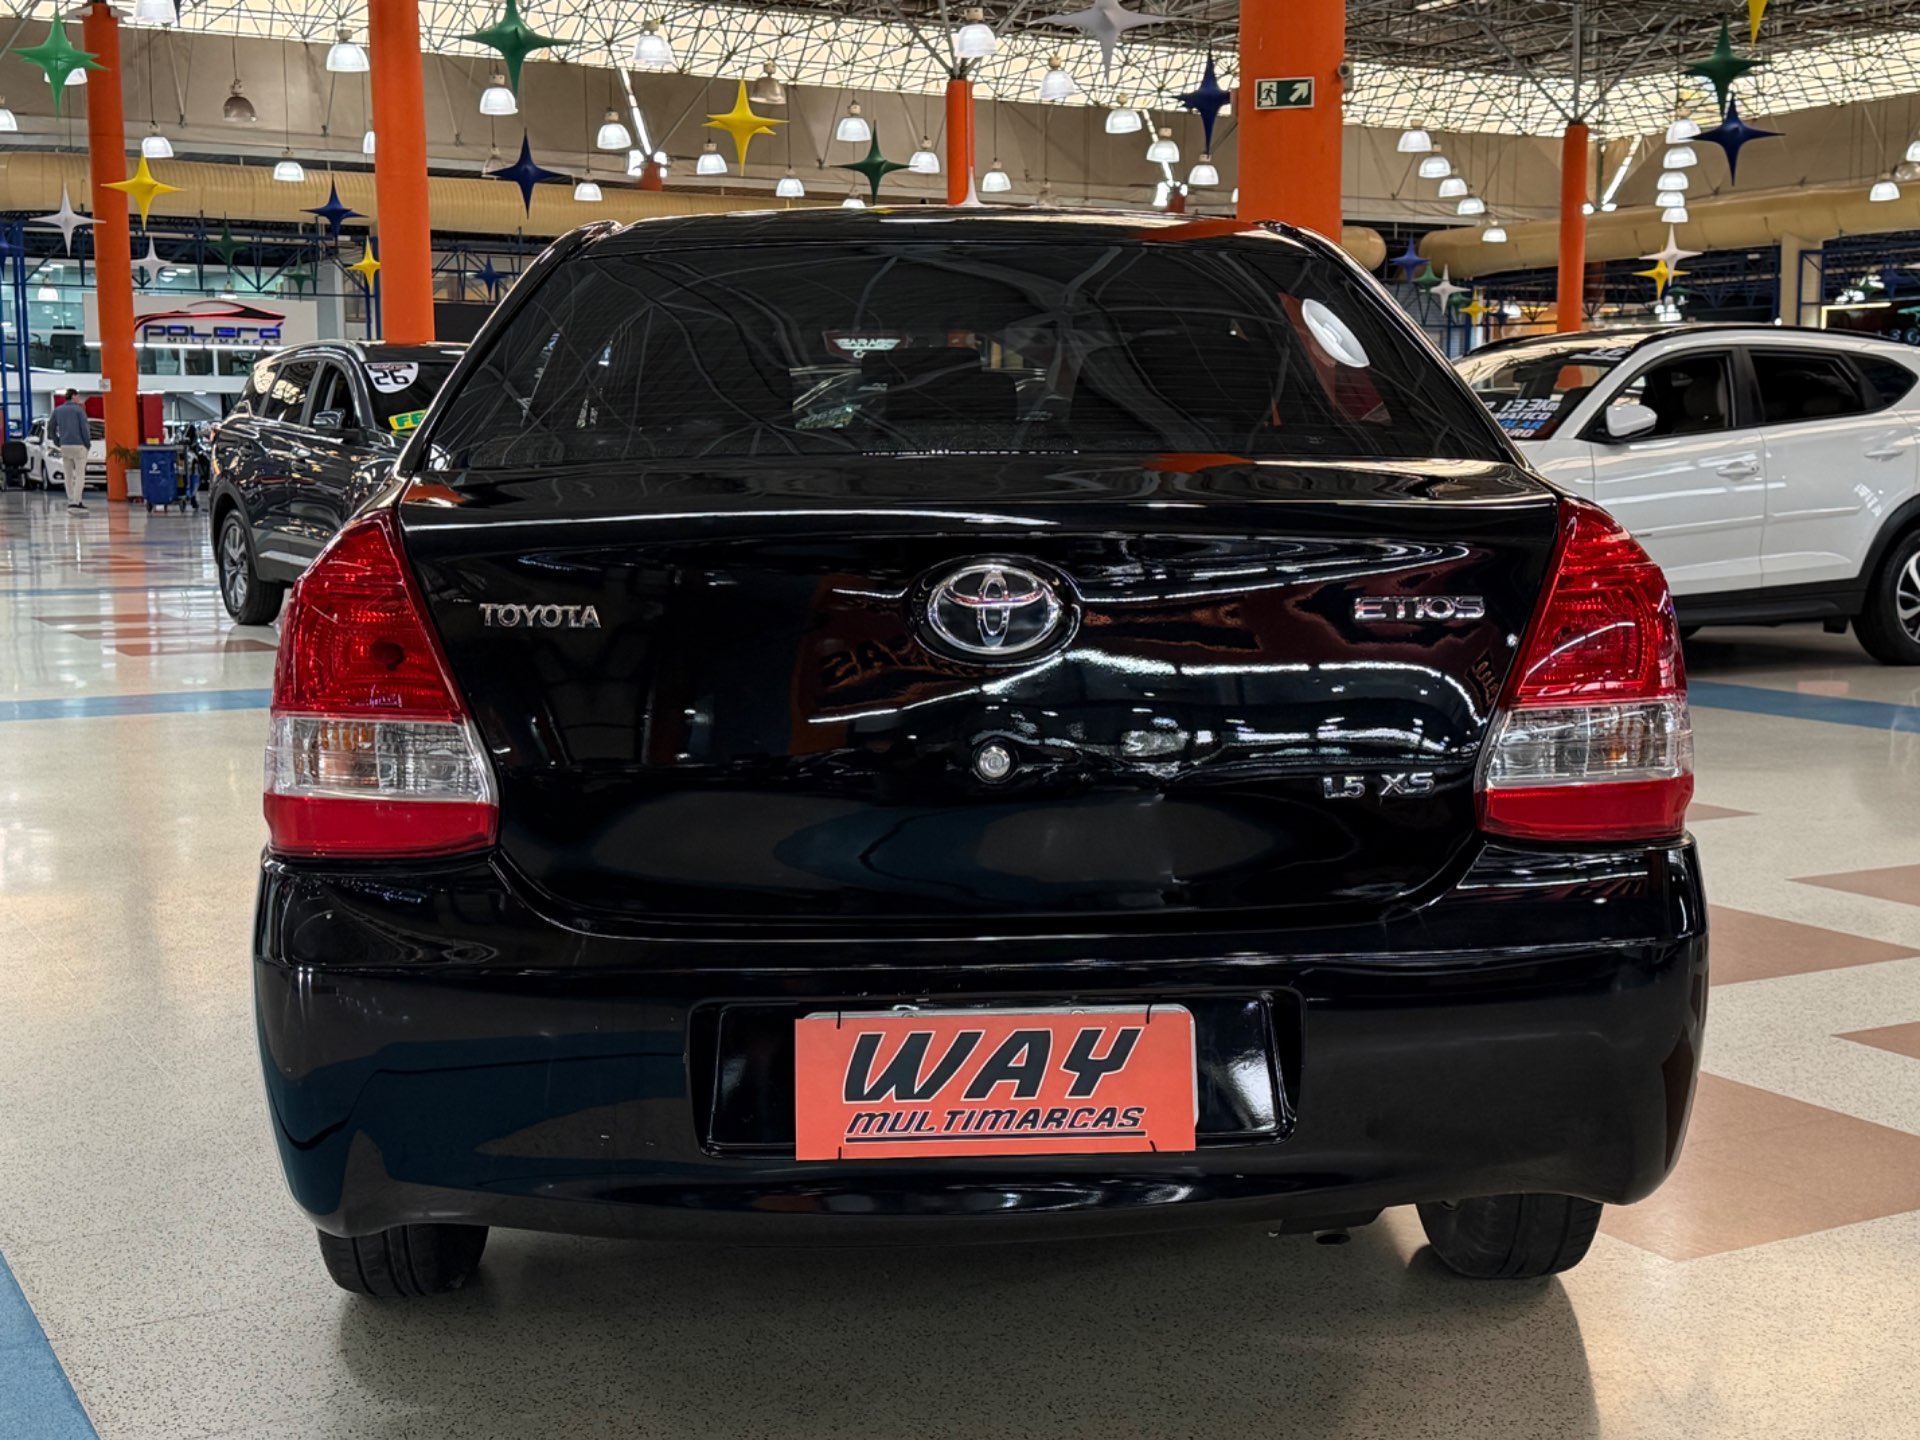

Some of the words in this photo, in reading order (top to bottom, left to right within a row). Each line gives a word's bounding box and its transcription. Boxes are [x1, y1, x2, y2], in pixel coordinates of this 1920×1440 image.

[479, 603, 601, 628] TOYOTA
[1354, 596, 1485, 619] ETIOS
[1380, 772, 1435, 796] XS
[843, 1026, 1144, 1104] WAY
